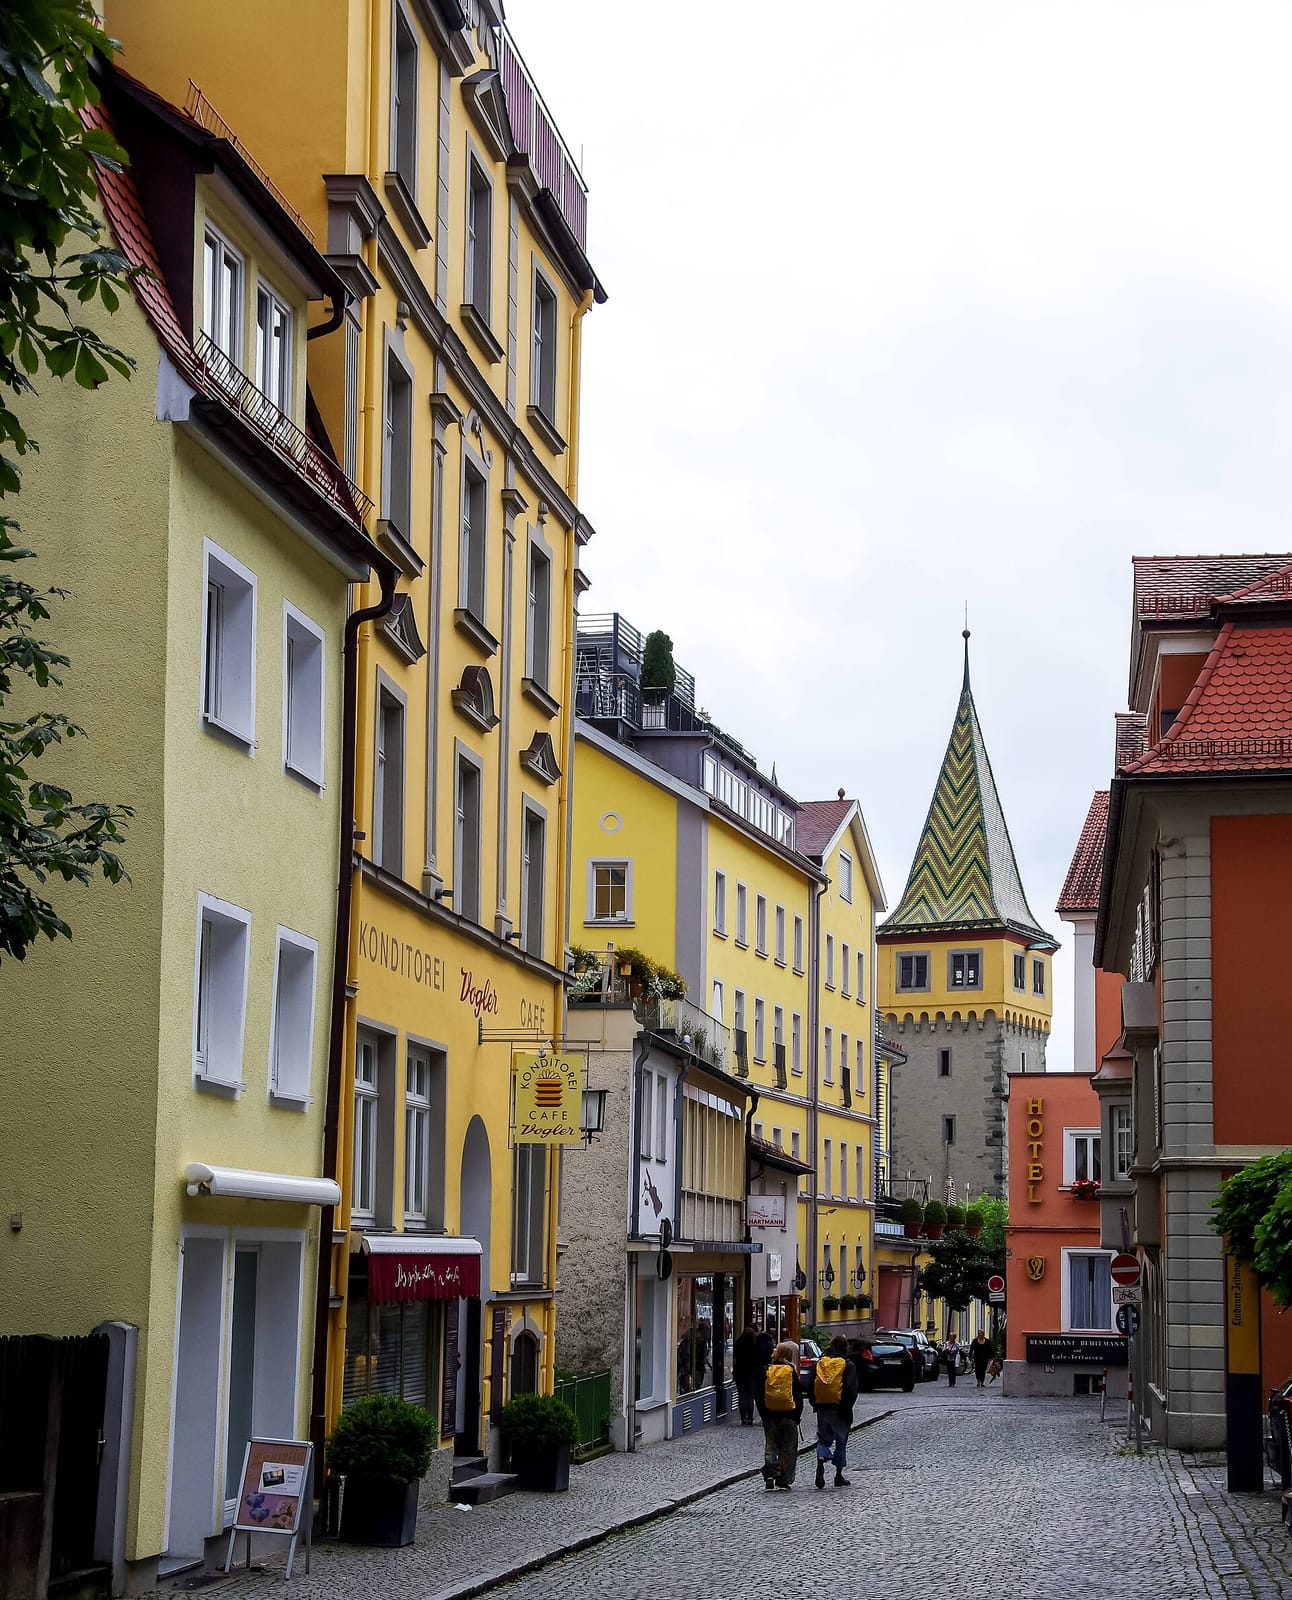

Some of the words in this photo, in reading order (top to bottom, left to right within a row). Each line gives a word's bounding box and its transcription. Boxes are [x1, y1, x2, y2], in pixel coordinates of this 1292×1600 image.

[359, 920, 445, 992] KONDITOREI
[460, 967, 498, 1018] Vogler
[520, 1058, 577, 1090] KONDITOREI
[521, 1123, 575, 1138] Vogler
[529, 1110, 568, 1121] CAFE
[1026, 1097, 1044, 1203] HOTEL
